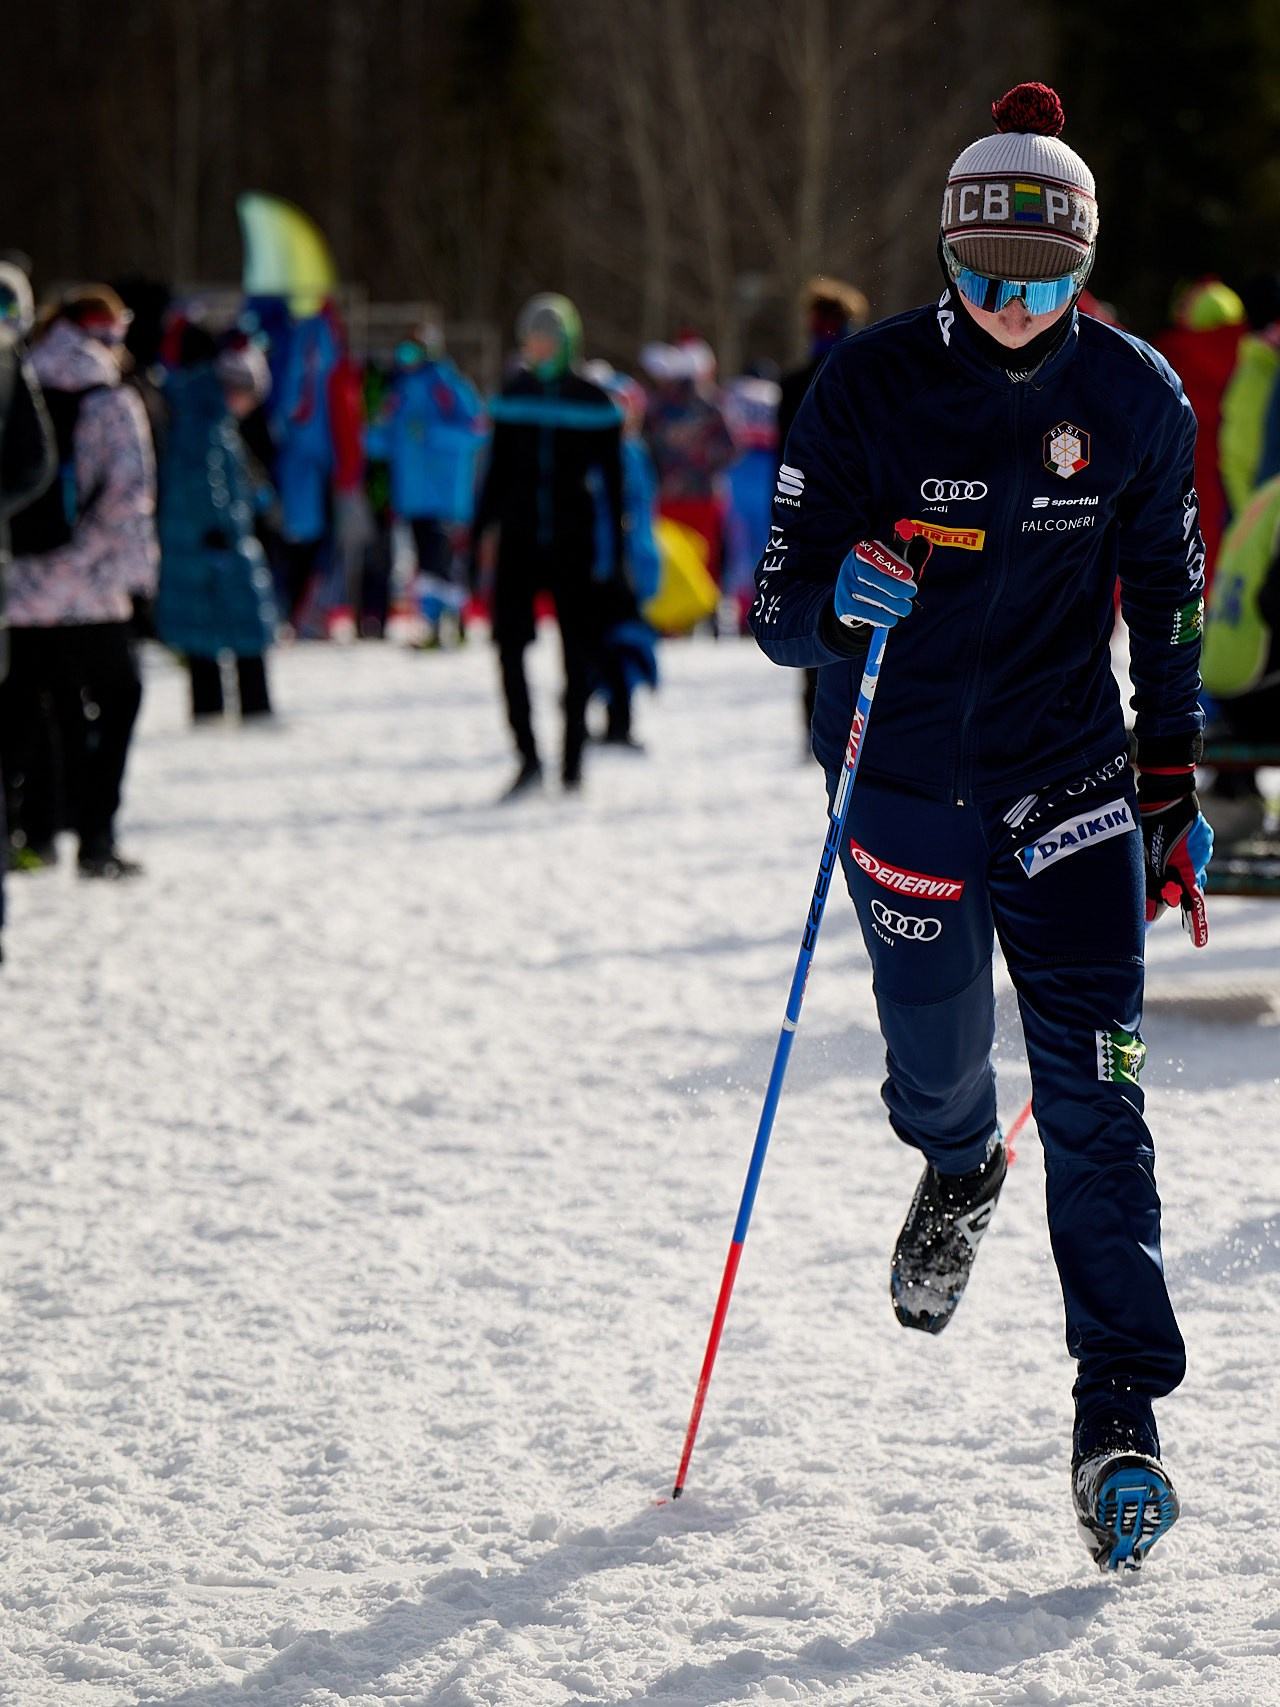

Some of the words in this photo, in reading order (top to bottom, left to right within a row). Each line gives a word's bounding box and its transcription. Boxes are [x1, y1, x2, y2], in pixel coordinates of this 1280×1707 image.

[1051, 495, 1099, 506] sportful
[1021, 515, 1095, 532] FALCONERI
[859, 540, 873, 553] SKI
[872, 547, 904, 577] TEAM
[1039, 807, 1130, 860] DAIKIN
[875, 866, 962, 898] ENERVIT
